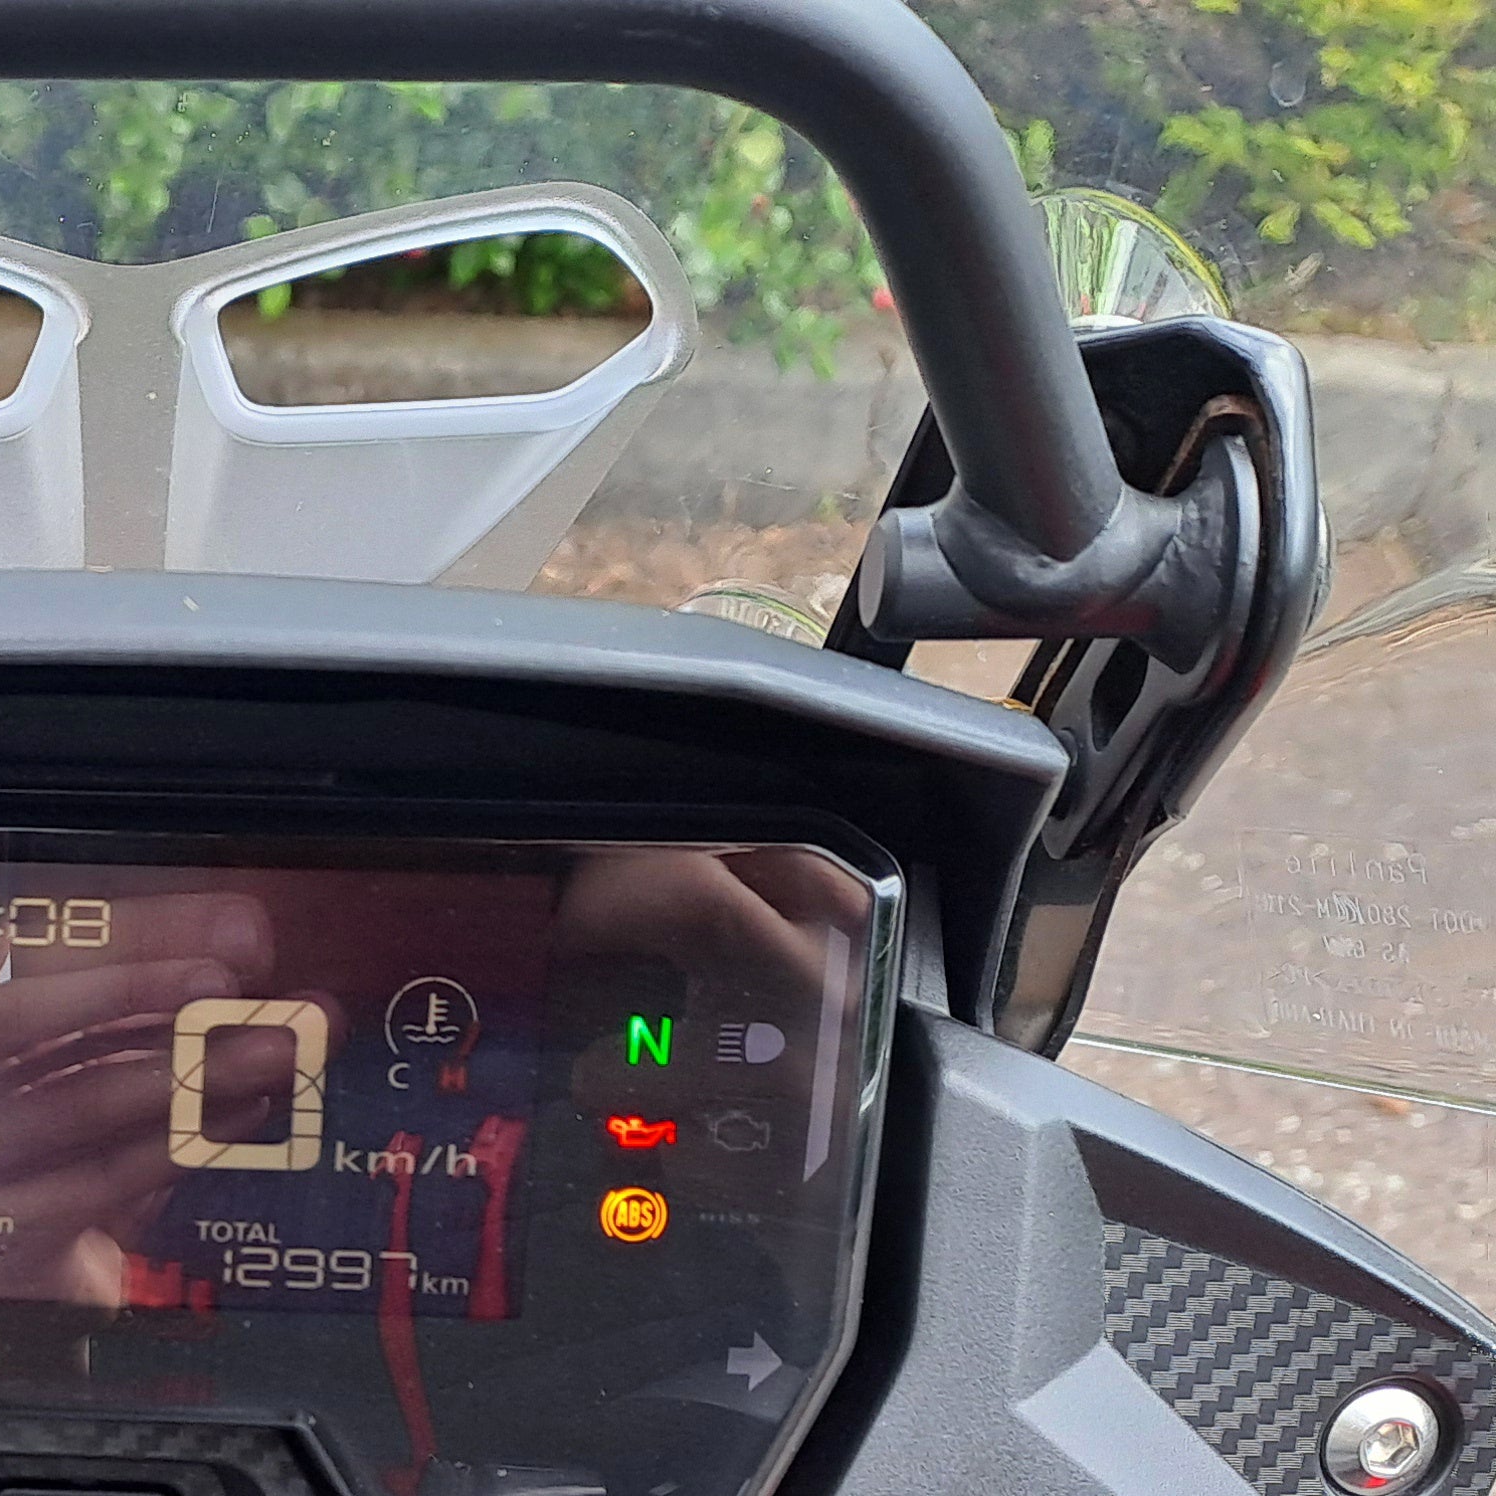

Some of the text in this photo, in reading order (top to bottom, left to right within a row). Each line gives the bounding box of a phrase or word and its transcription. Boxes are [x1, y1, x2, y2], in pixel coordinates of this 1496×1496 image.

[626, 1014, 674, 1067] N
[168, 998, 329, 1171] 0
[388, 1062, 410, 1089] C
[334, 1140, 477, 1176] km/h
[195, 1220, 281, 1243] TOTAL
[615, 1200, 653, 1228] ABS
[223, 1247, 470, 1295] 12997 km
